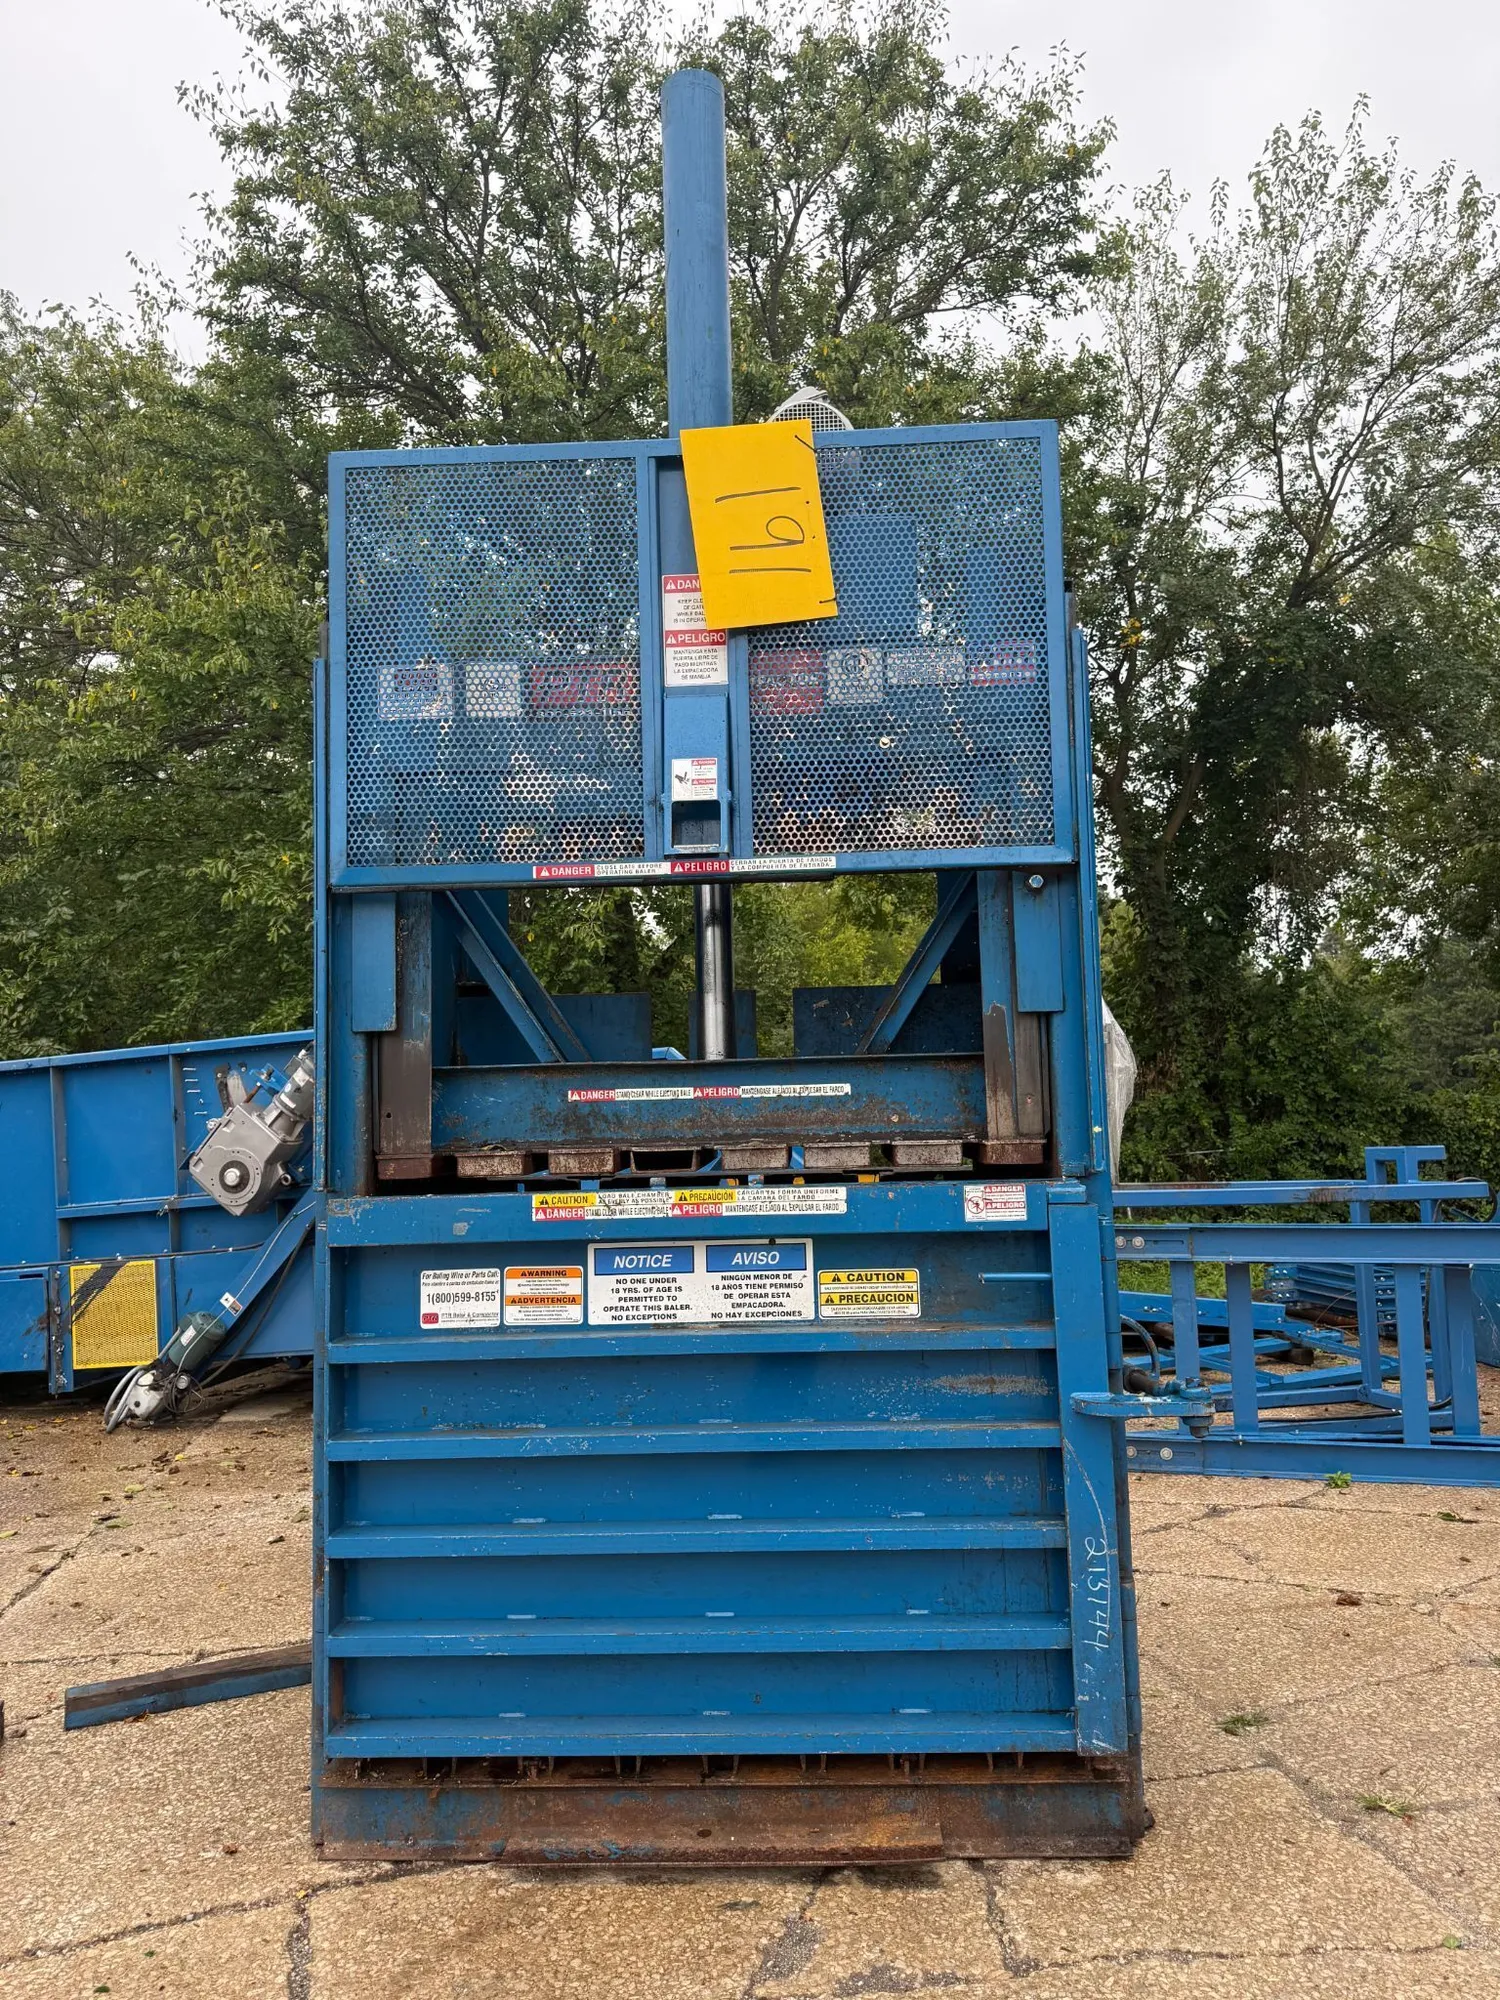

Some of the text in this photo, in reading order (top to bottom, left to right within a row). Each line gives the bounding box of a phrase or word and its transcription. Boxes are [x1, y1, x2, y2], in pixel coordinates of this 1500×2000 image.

[678, 632, 725, 643] PELIGRO
[551, 866, 592, 876] DANGER
[684, 860, 726, 872] PELIGRO
[581, 1090, 615, 1100] DANGER
[704, 1087, 739, 1097] PELIGRO
[551, 1195, 588, 1205] CAUTION
[618, 1207, 633, 1215] WHILE
[682, 1204, 722, 1215] PELIGRO
[781, 1203, 788, 1211] AL
[789, 1203, 815, 1211] EXPULSAR
[815, 1203, 822, 1211] EL
[822, 1202, 839, 1211] FARDO
[546, 1208, 584, 1218] DANGER
[613, 1254, 672, 1268] NOTICE
[731, 1251, 779, 1265] AVISO
[432, 1272, 450, 1280] Baling
[450, 1271, 463, 1279] Wire
[721, 1273, 751, 1281] NINGÚN
[847, 1273, 905, 1281] CAUTION
[427, 1292, 496, 1305] 1(800)599-8155
[839, 1293, 914, 1303] PRECAUCION
